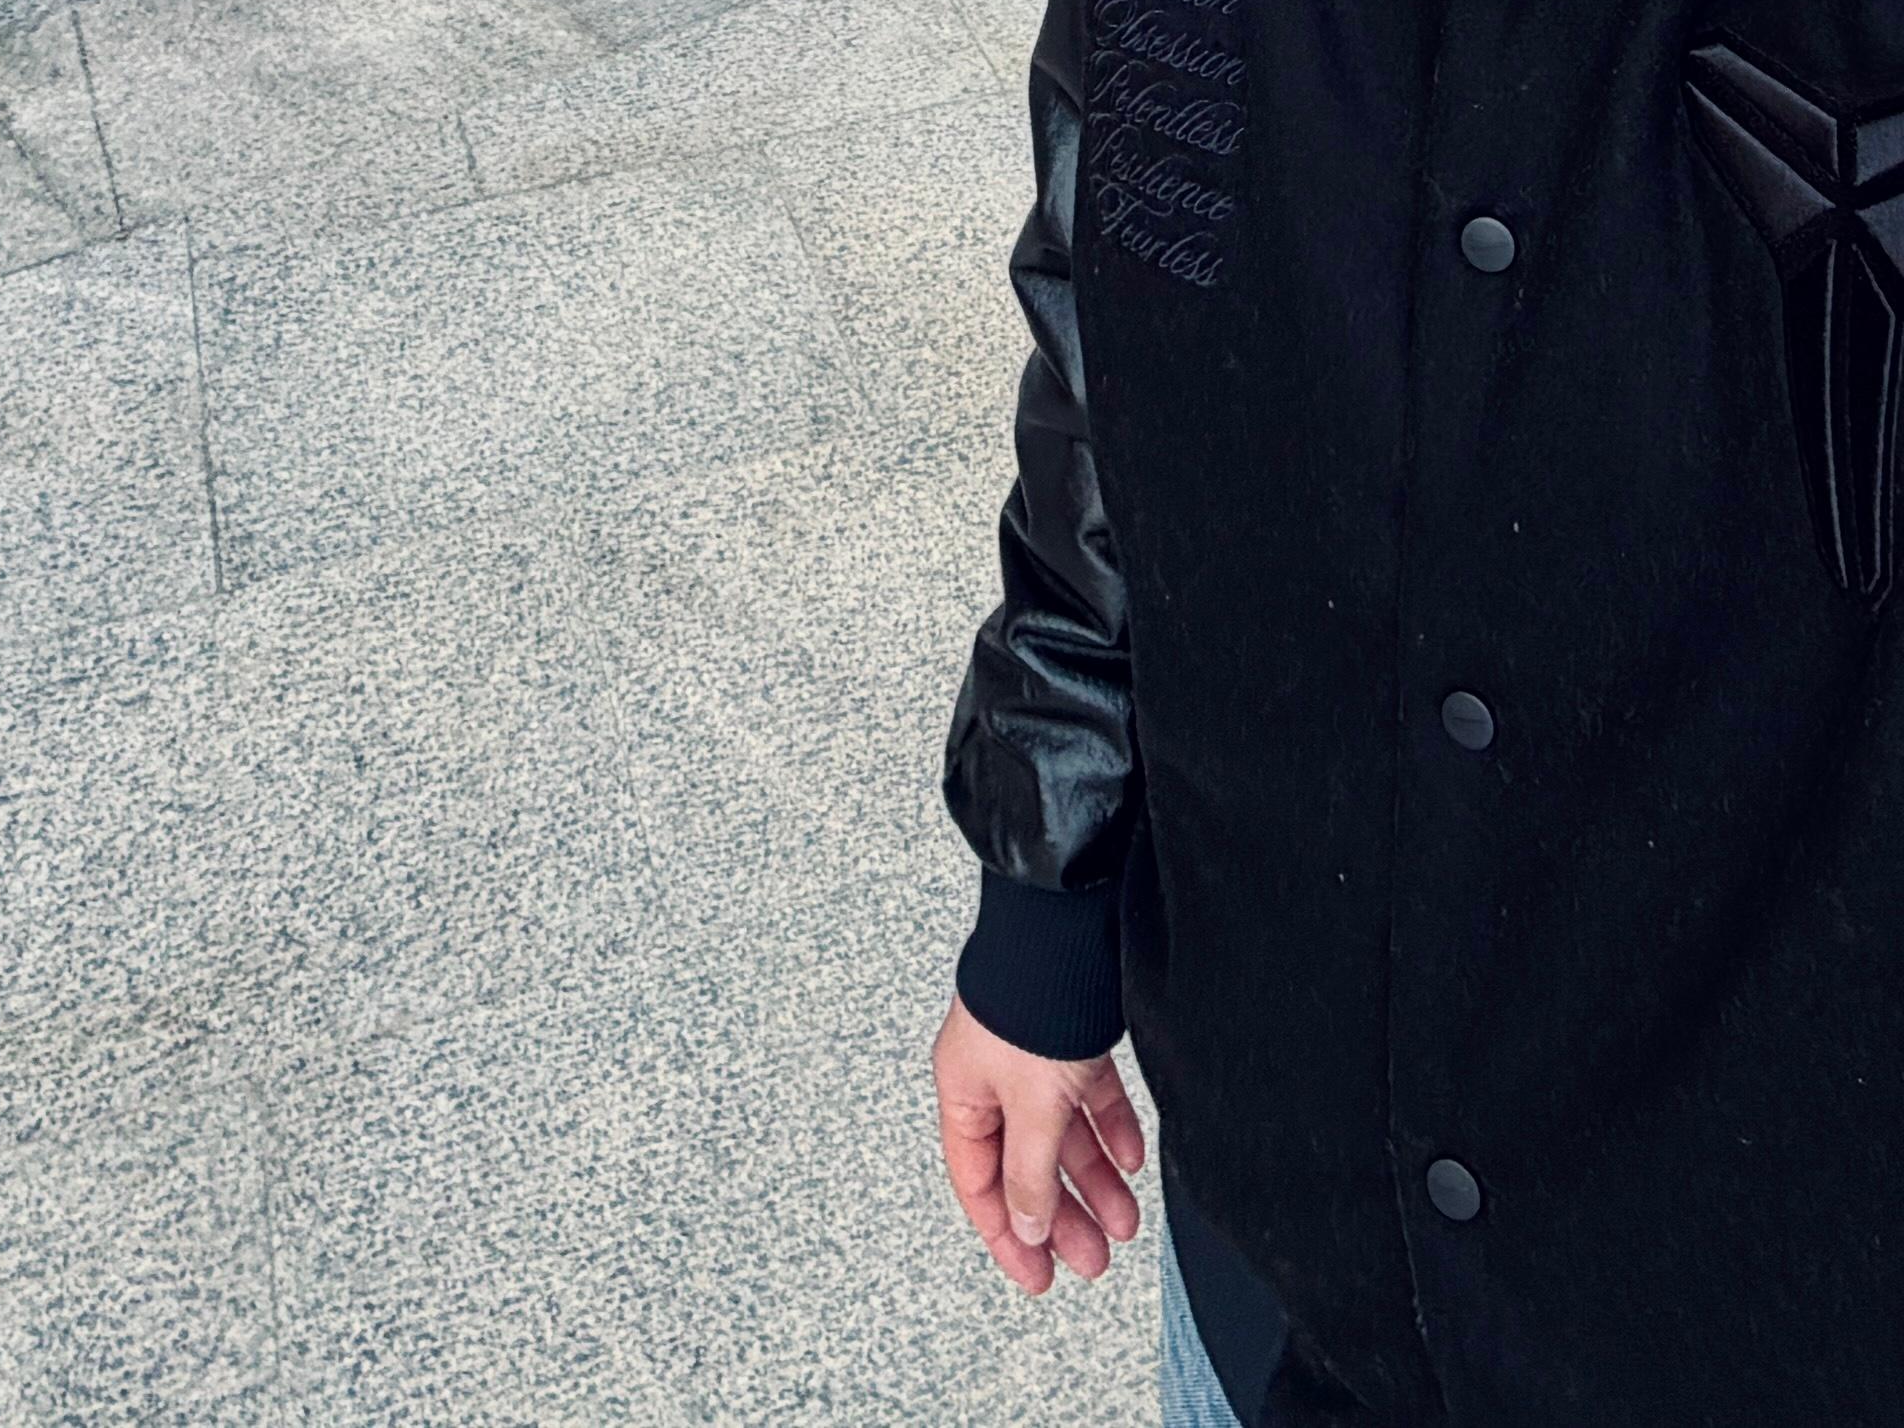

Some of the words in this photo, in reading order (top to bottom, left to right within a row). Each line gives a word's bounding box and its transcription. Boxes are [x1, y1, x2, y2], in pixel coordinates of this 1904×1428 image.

[1089, 50, 1245, 155] Relentless
[1088, 113, 1233, 220] Resilience
[1091, 174, 1224, 287] Fearless
